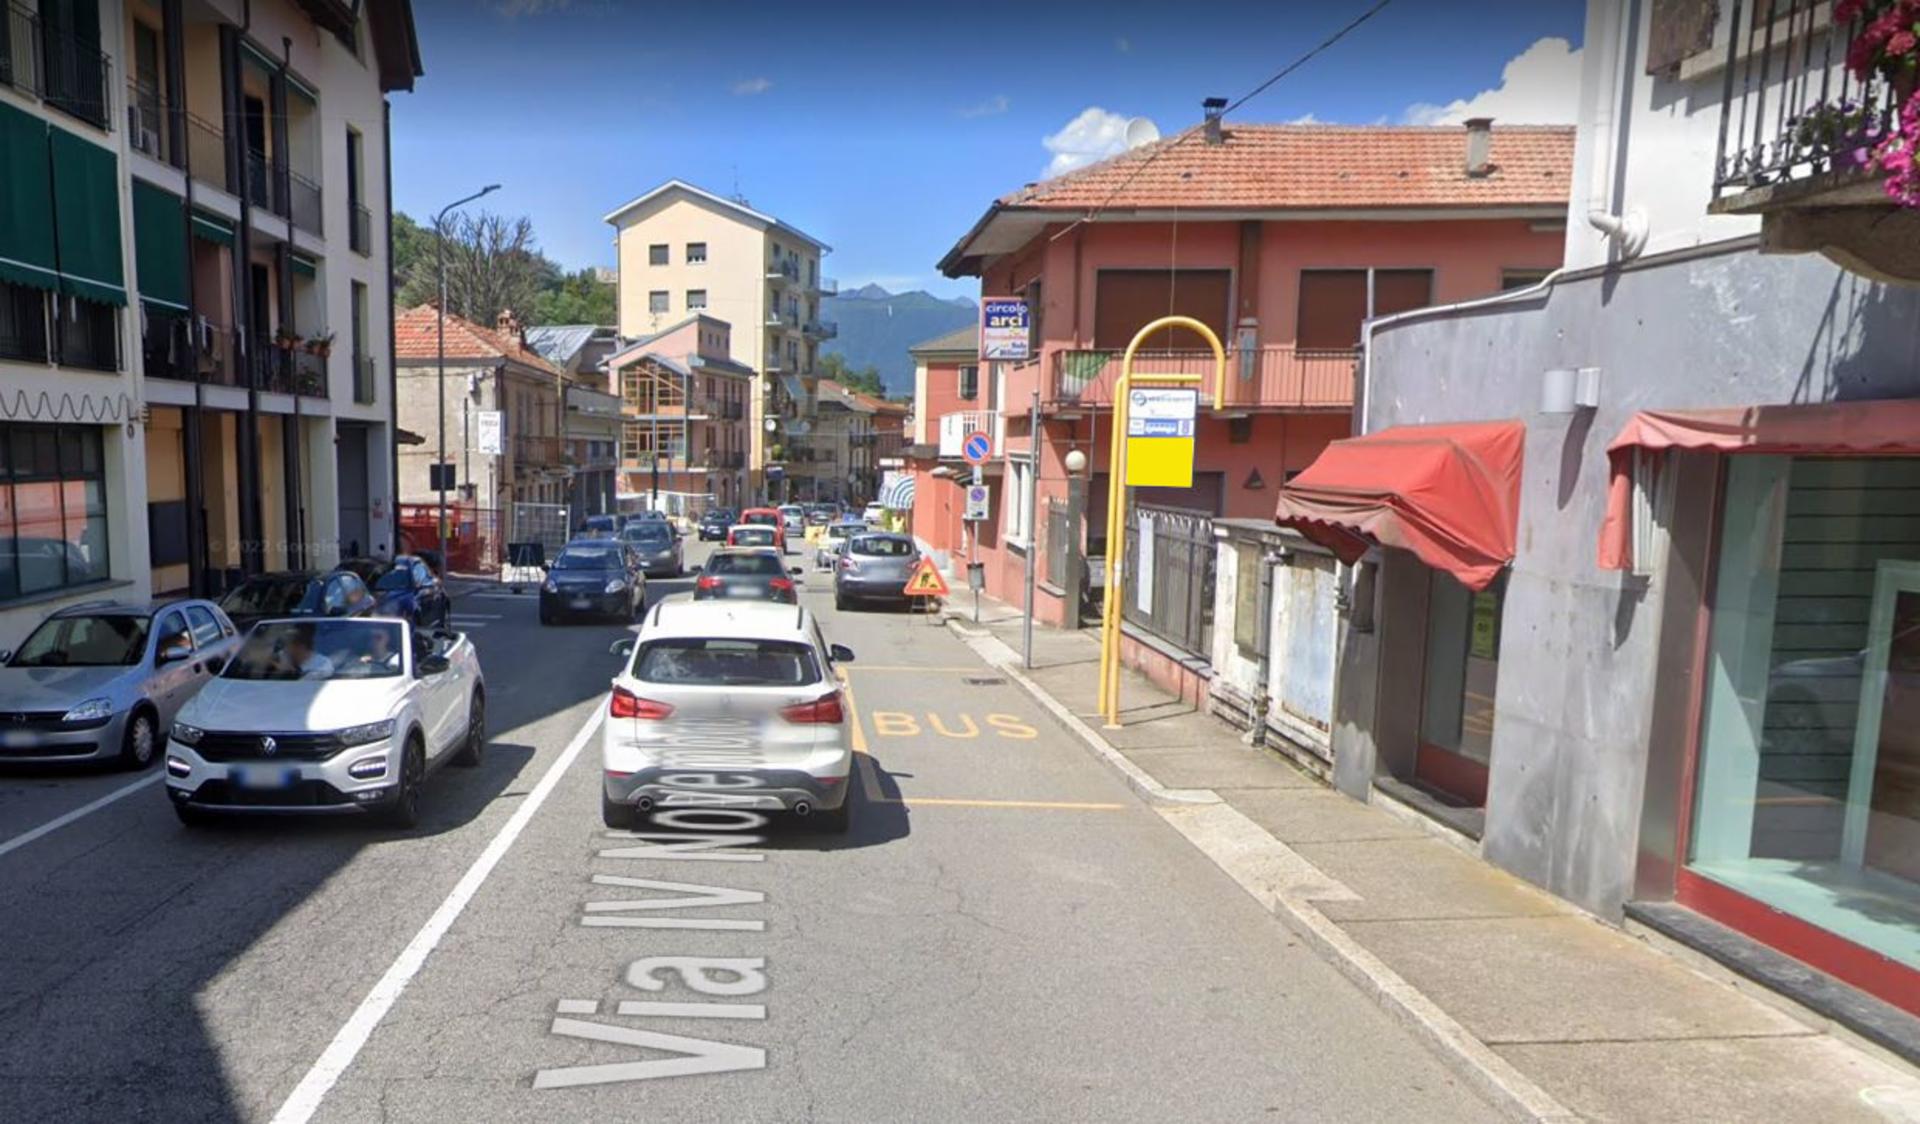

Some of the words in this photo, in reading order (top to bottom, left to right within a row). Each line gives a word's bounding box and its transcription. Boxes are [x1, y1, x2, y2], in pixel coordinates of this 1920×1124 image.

[986, 302, 1028, 314] circolo
[990, 312, 1023, 327] arci
[872, 710, 1038, 739] BUS
